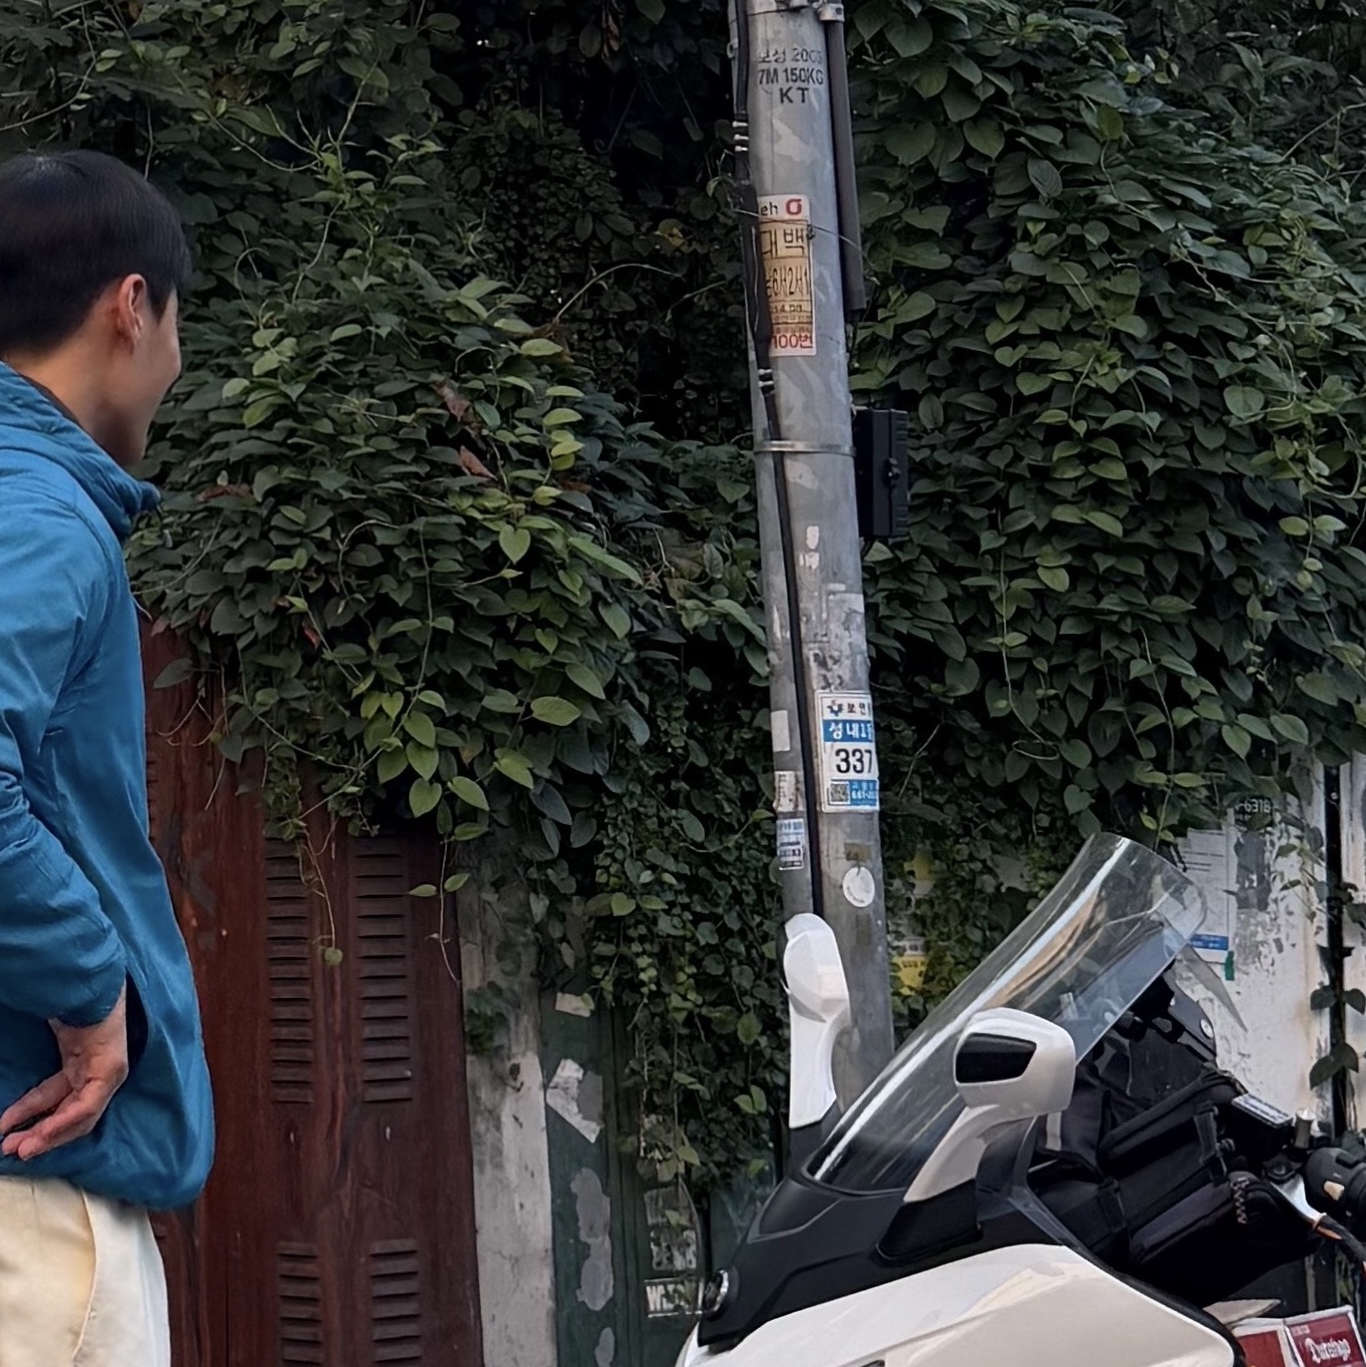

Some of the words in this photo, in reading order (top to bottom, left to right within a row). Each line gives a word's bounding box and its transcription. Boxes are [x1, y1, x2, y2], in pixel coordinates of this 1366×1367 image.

[758, 67, 779, 85] 7M
[783, 67, 824, 85] 150KG
[779, 86, 809, 104] KT
[847, 702, 872, 717] 보안
[835, 748, 873, 774] 337
